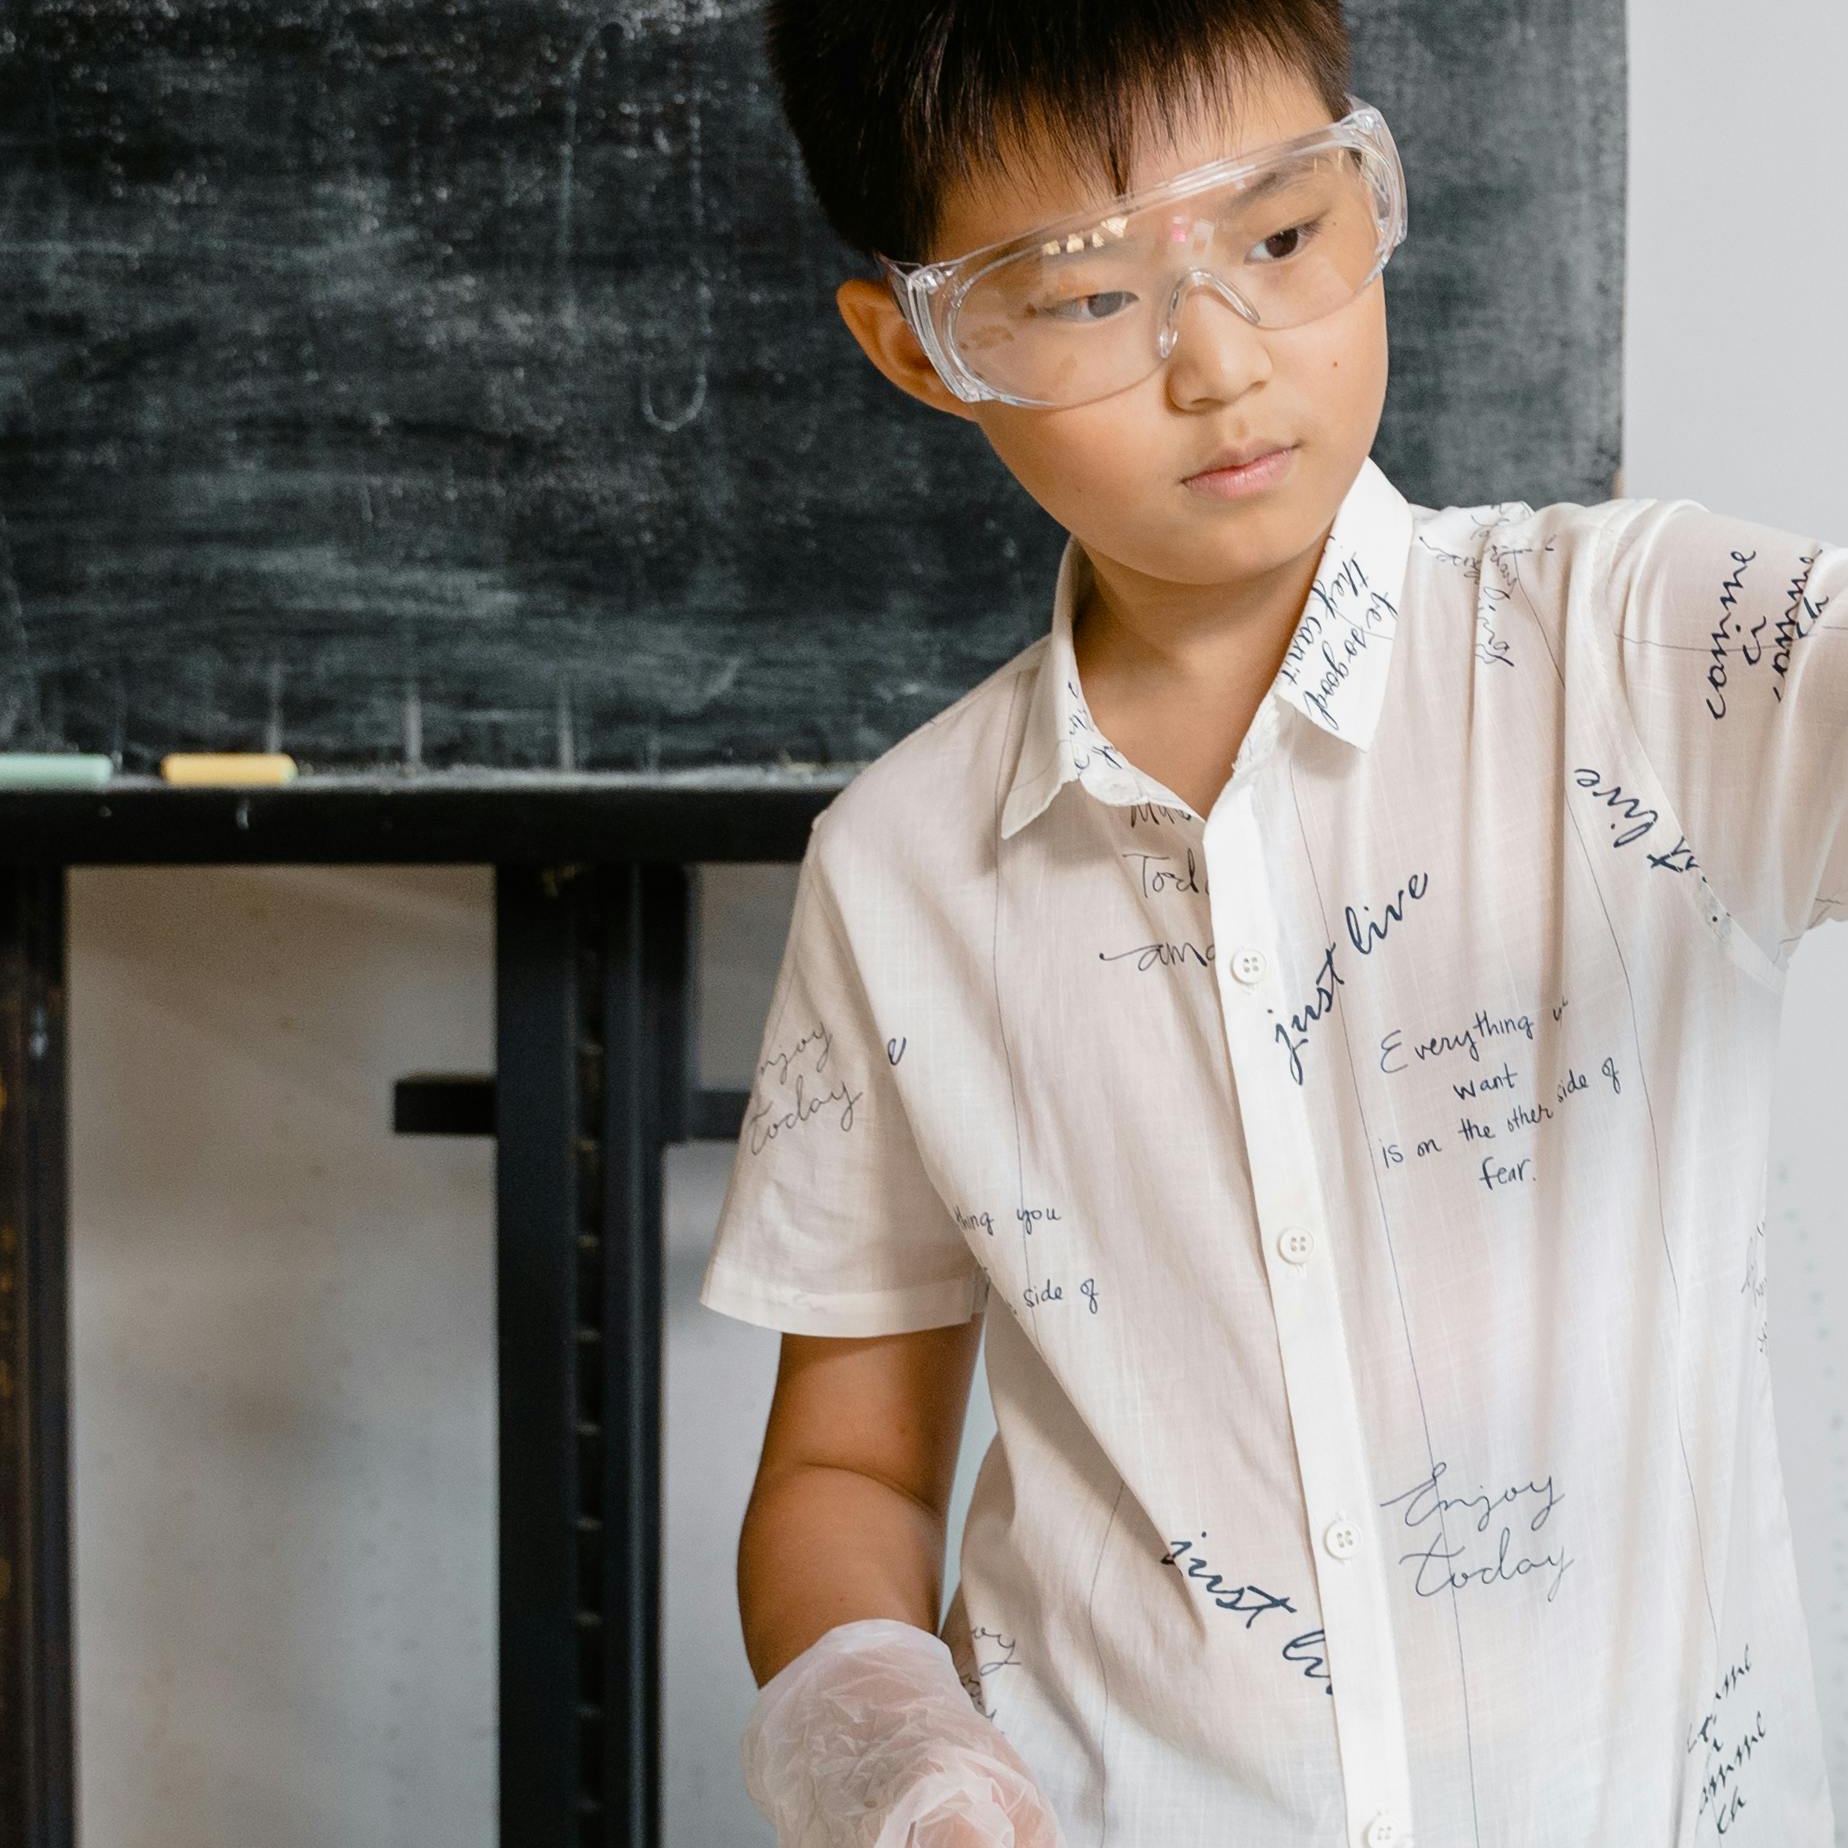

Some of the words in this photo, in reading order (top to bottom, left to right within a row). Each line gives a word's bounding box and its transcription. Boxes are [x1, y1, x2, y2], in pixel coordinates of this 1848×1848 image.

[1267, 941, 1346, 1086] just
[1344, 872, 1429, 955] live
[760, 1021, 834, 1086] njoy
[1379, 1009, 1535, 1075] Everything
[1452, 1063, 1520, 1100] want
[1381, 1138, 1404, 1169] is
[1416, 1137, 1443, 1155] on
[1457, 1117, 1496, 1142] the
[1506, 1102, 1555, 1135] other
[1556, 1072, 1590, 1104] side
[1016, 1207, 1062, 1235] you
[1022, 1278, 1064, 1309] side
[1379, 1461, 1566, 1533] Enjoy
[1398, 1526, 1576, 1603] today
